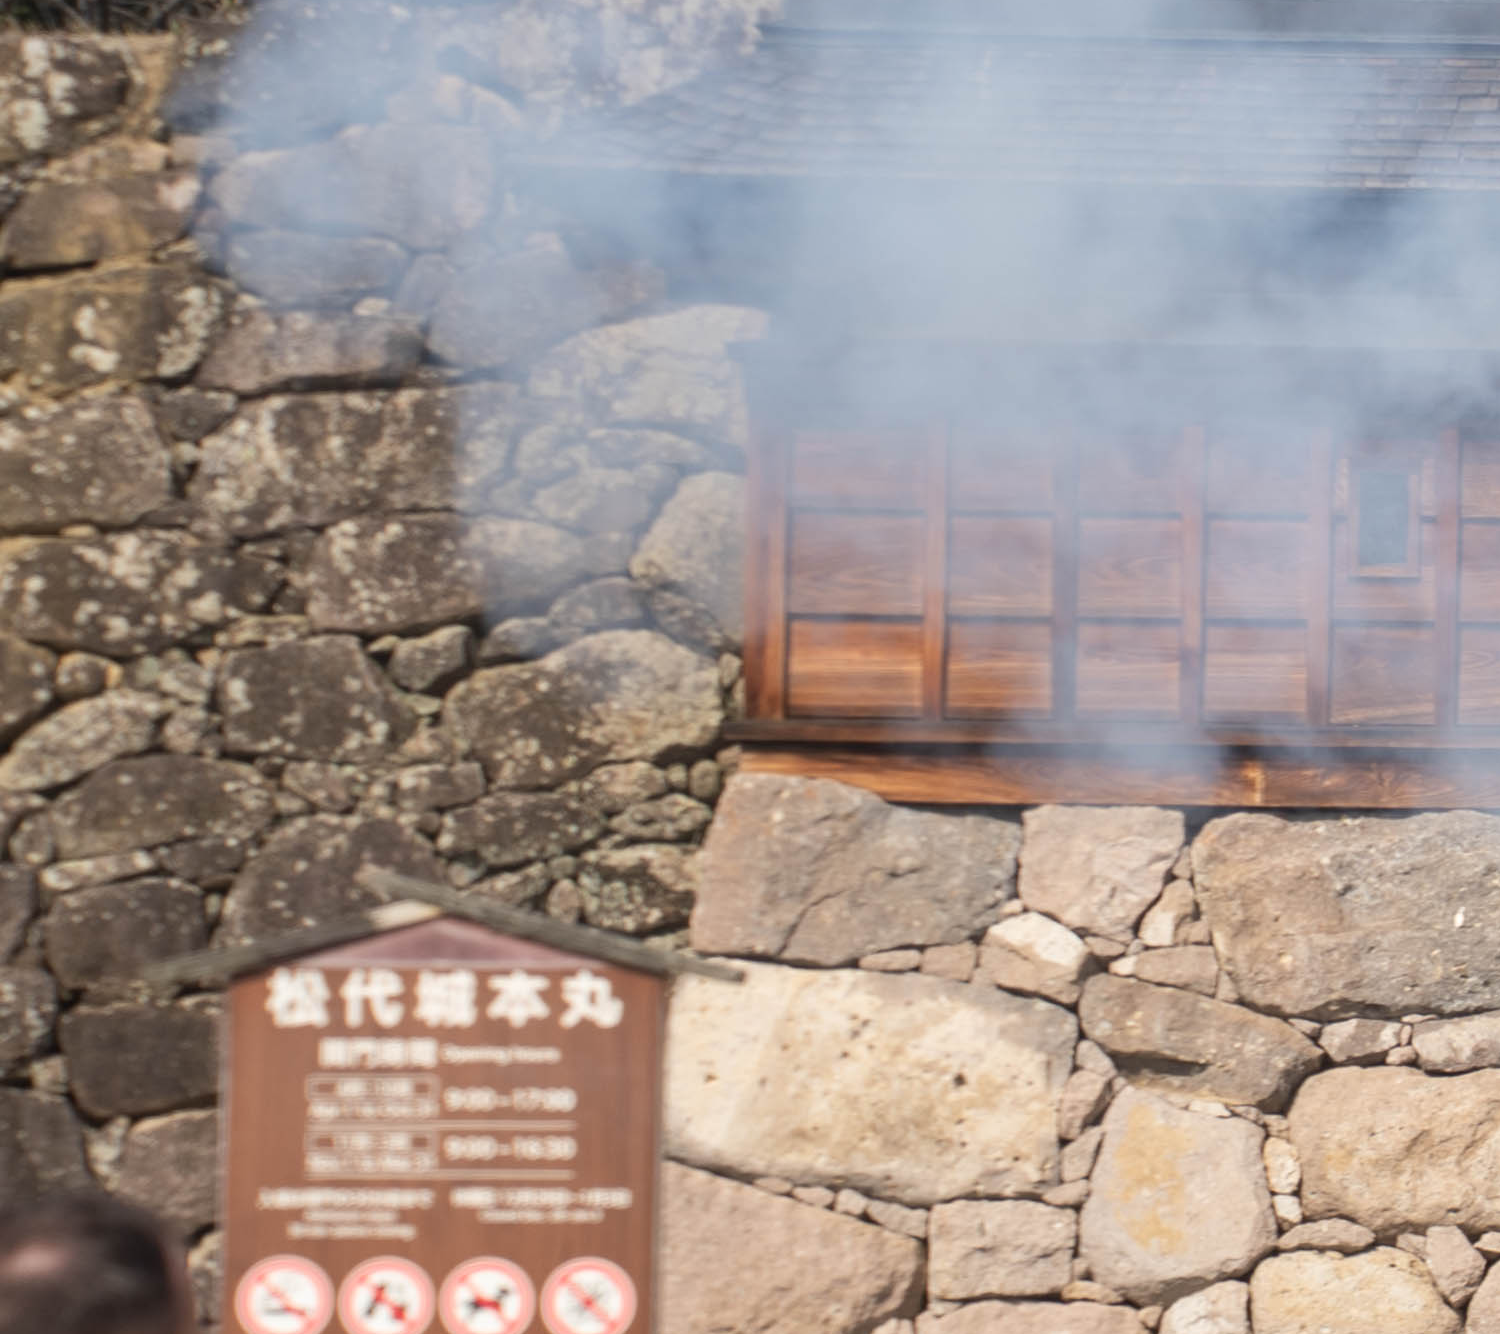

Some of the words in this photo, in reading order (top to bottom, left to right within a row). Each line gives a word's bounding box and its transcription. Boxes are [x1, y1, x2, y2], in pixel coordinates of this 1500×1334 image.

[266, 970, 623, 1028] 松代城本丸
